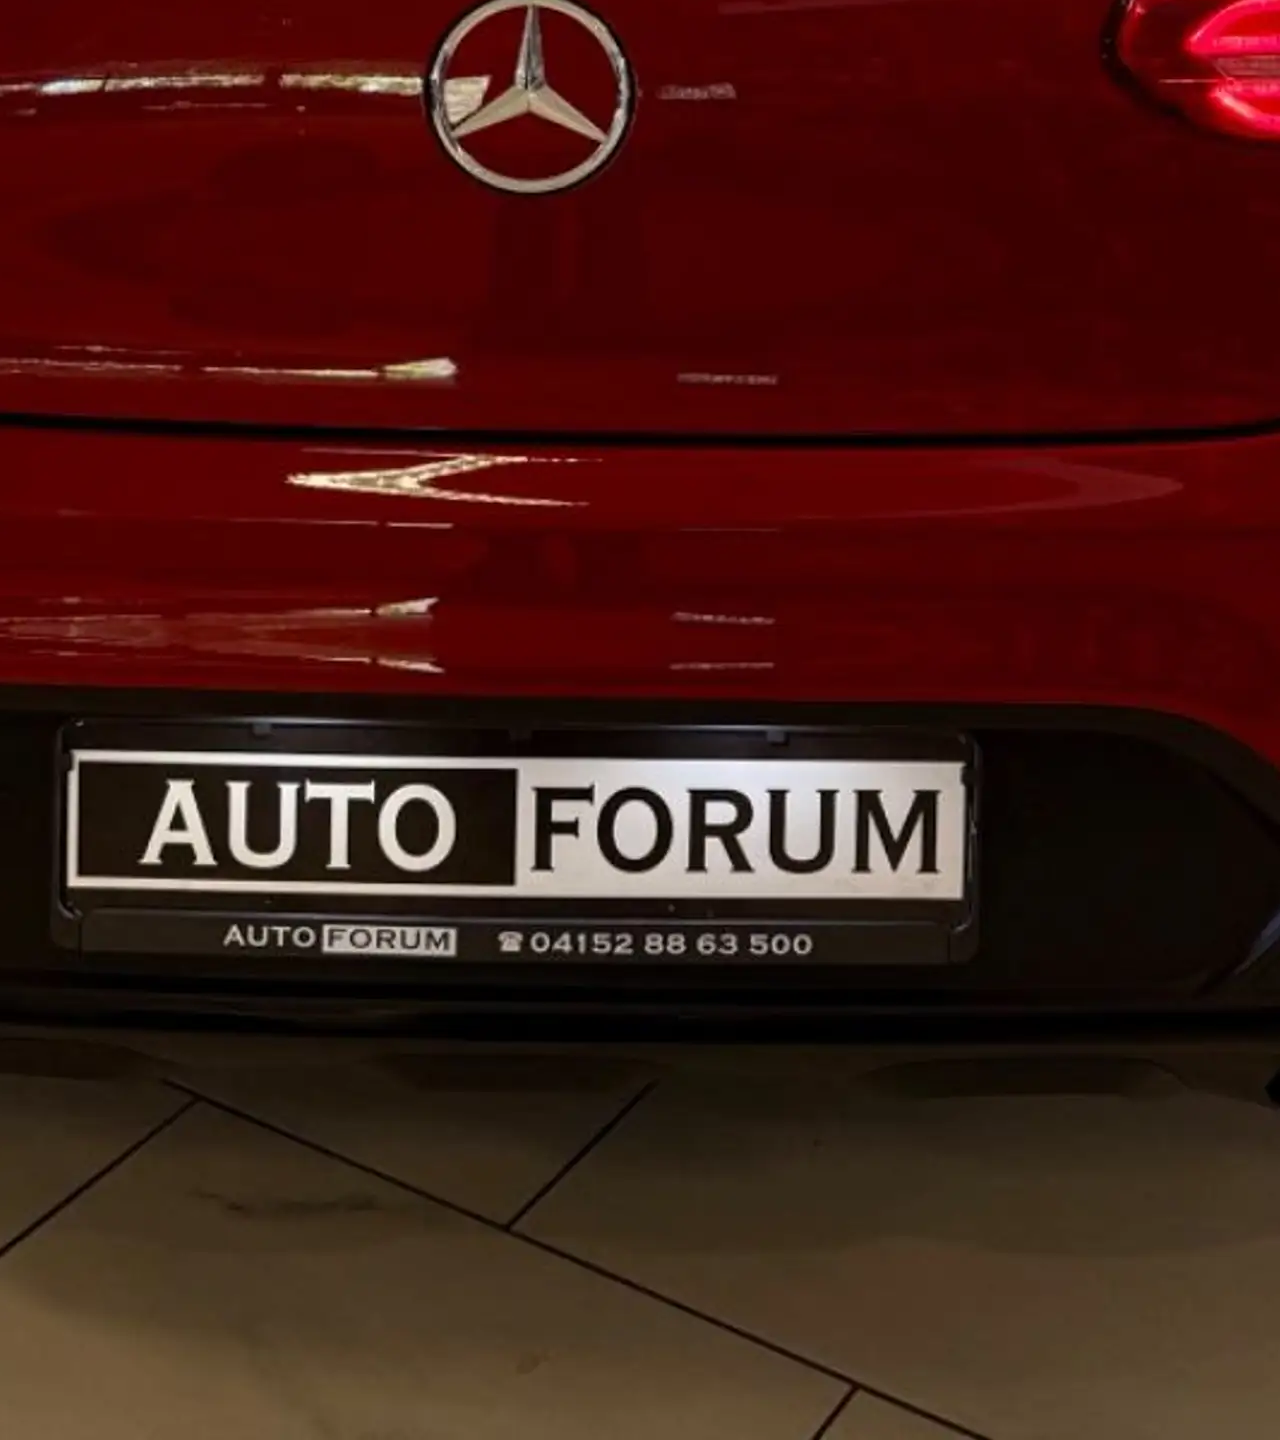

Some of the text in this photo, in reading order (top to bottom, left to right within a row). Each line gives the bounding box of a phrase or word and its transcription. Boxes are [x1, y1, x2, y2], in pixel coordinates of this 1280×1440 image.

[138, 778, 941, 874] AUTO FORUM
[223, 923, 452, 952] AUTO FORUM
[530, 931, 813, 955] 04152 88 63 500
